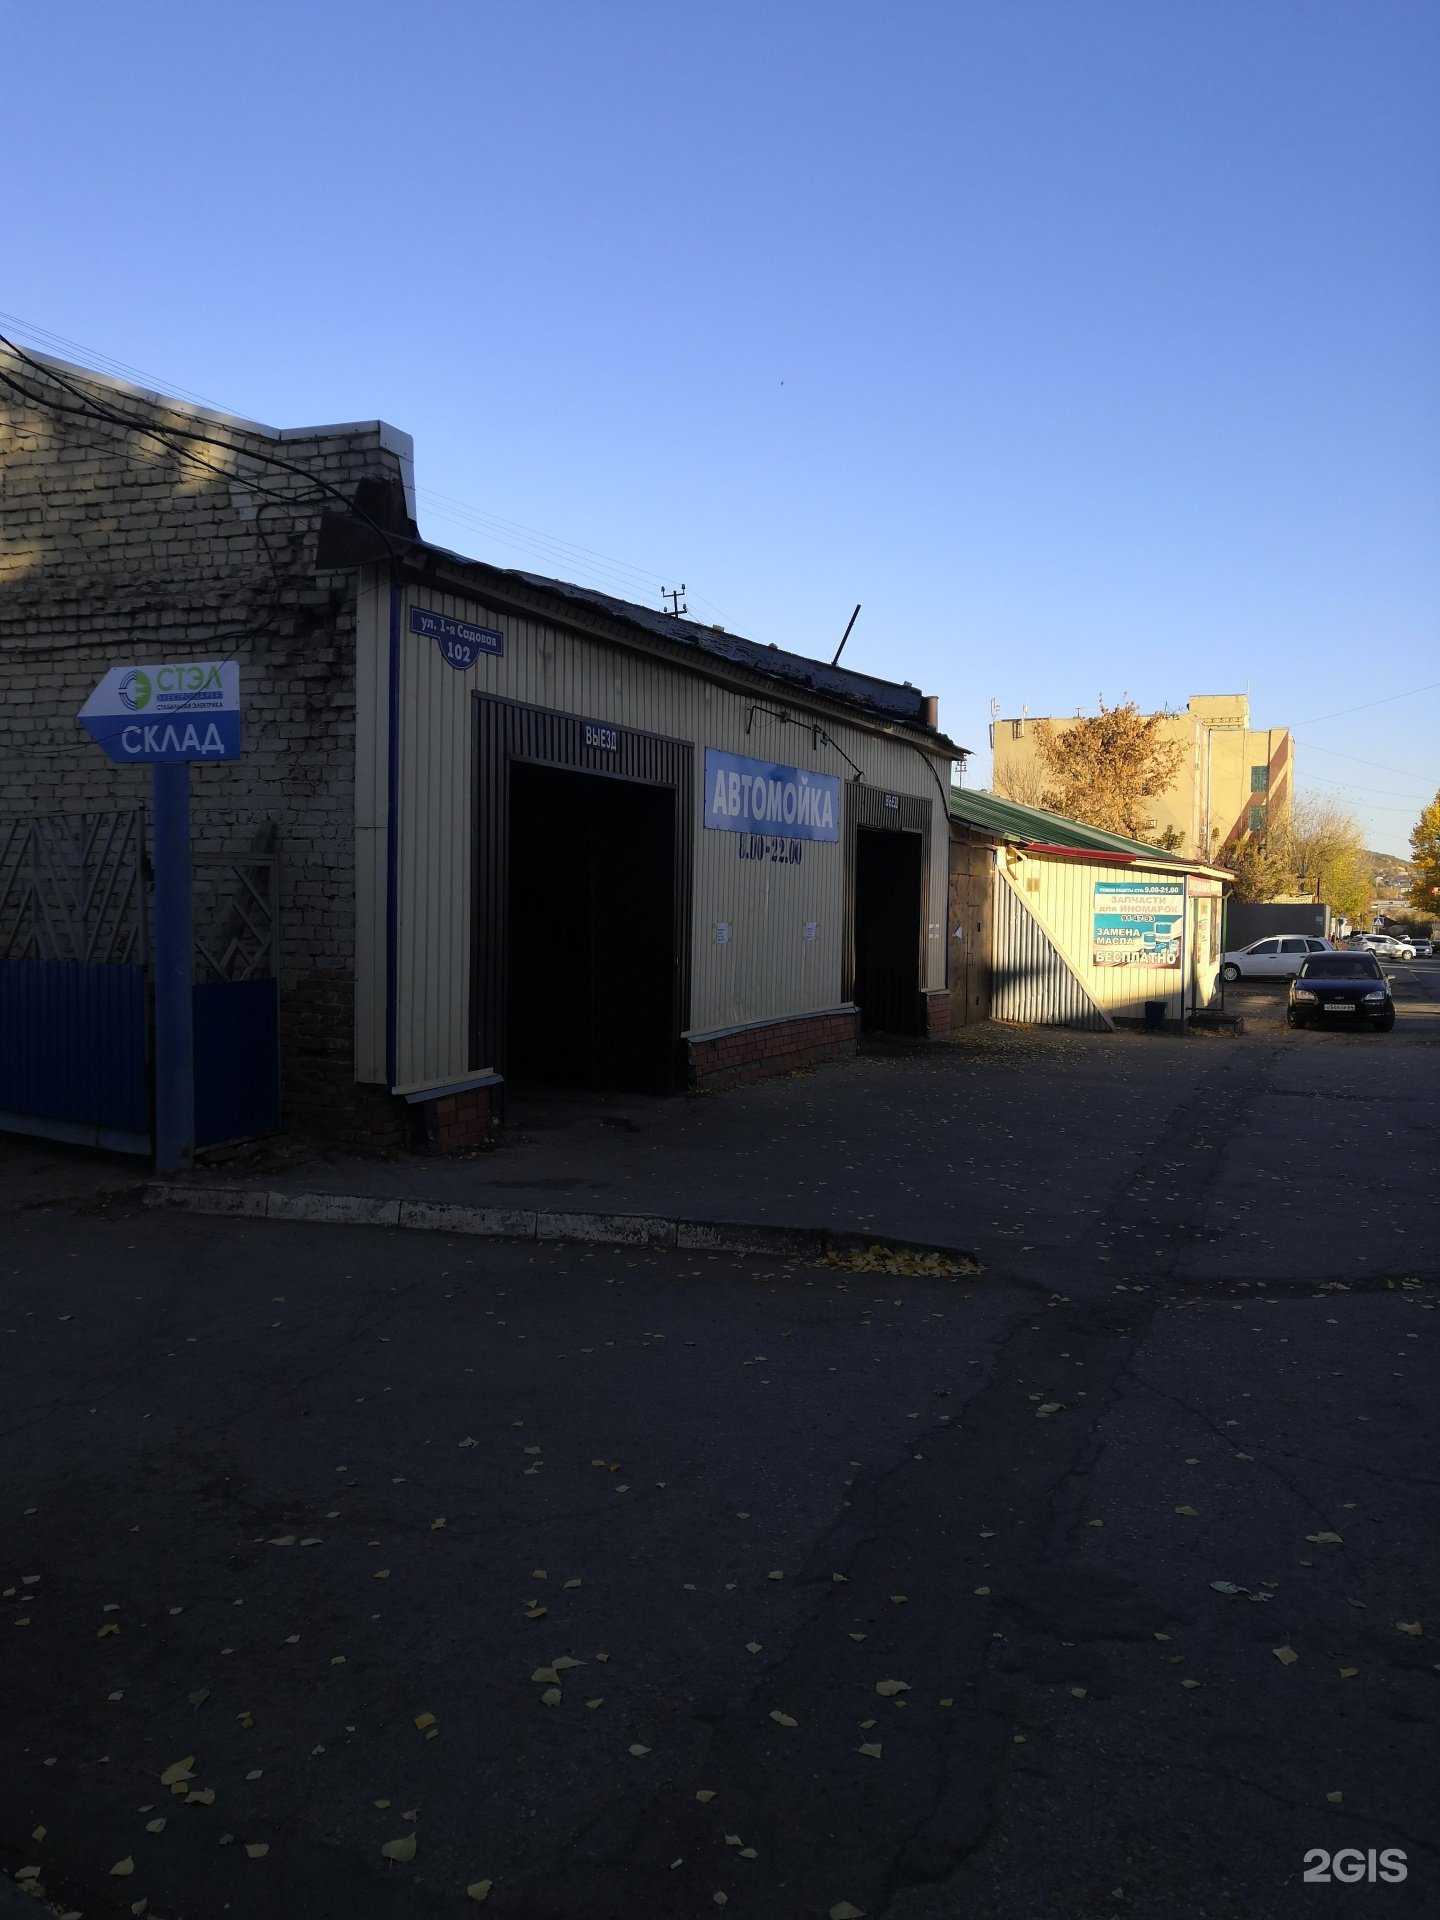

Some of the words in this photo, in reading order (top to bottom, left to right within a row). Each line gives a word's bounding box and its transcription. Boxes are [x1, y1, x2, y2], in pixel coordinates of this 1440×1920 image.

[457, 625, 497, 646] Садовая
[448, 641, 471, 662] 102
[156, 666, 223, 691] СТЭЛ
[121, 723, 225, 754] СКЛАД
[585, 726, 617, 751] ВЫЕЗД
[712, 769, 833, 828] АВТОМОЙКА
[1112, 896, 1166, 904] ЗАПЧАСТИ
[1120, 905, 1178, 913] ИНОМАРОК
[1096, 928, 1140, 937] ЗАМЕНА
[1095, 950, 1177, 965] БЕСПЛАТНО
